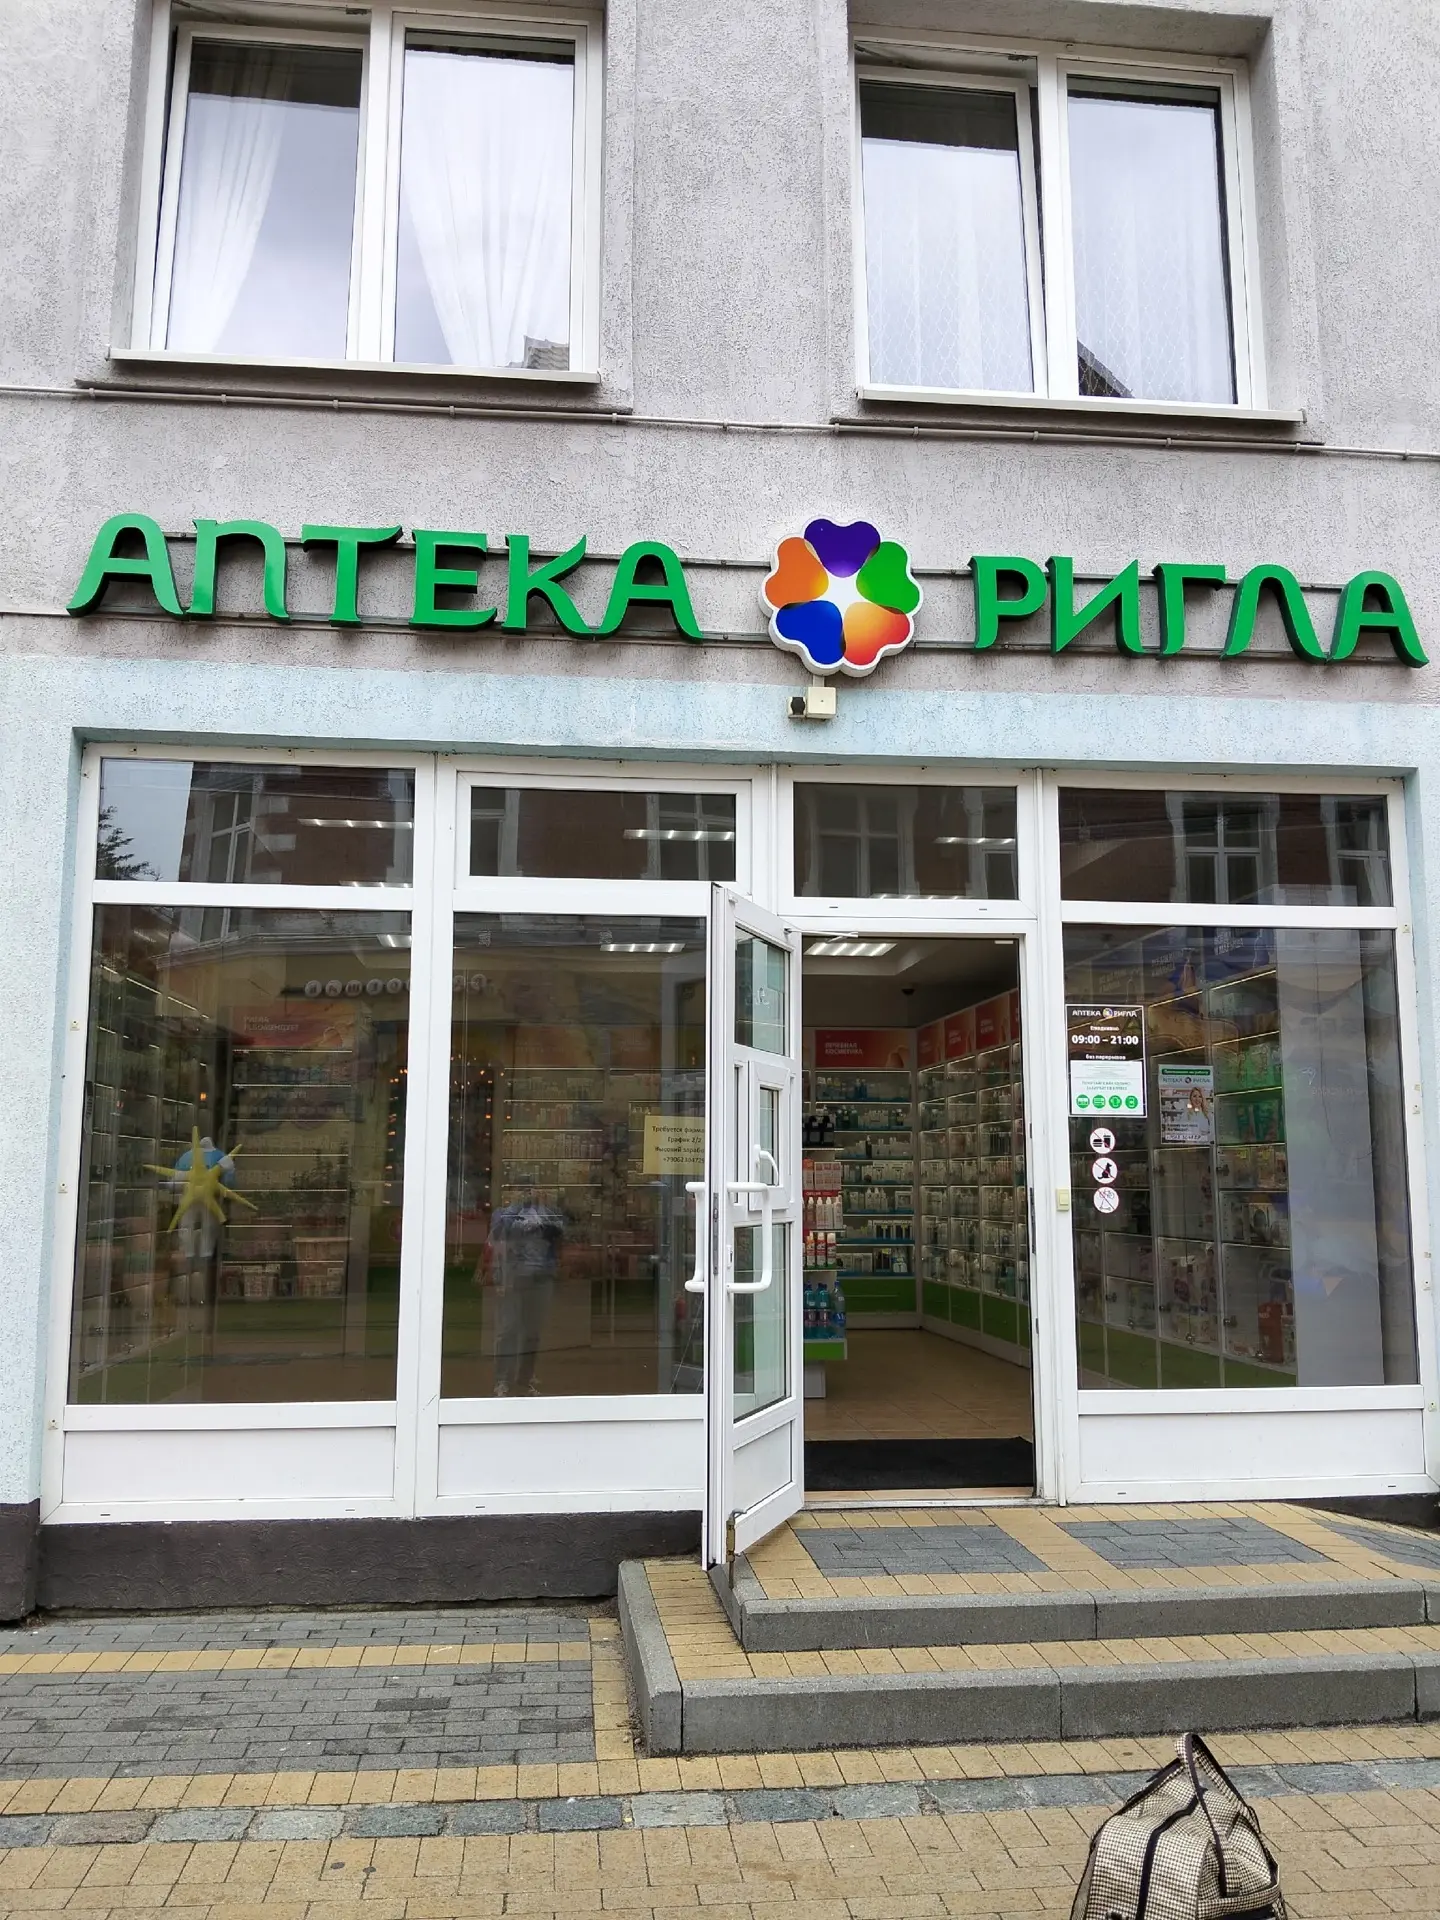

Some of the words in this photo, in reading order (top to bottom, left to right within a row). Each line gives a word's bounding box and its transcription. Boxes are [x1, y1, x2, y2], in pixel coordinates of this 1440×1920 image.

[66, 512, 703, 644] АПТЕКА
[968, 555, 1430, 668] РИГЛА
[1072, 1009, 1102, 1017] АПТЕКА
[1113, 1010, 1138, 1018] РИГЛА
[1071, 1034, 1101, 1044] 09:00
[1110, 1035, 1139, 1045] 21:00
[691, 1136, 702, 1144] 2/2
